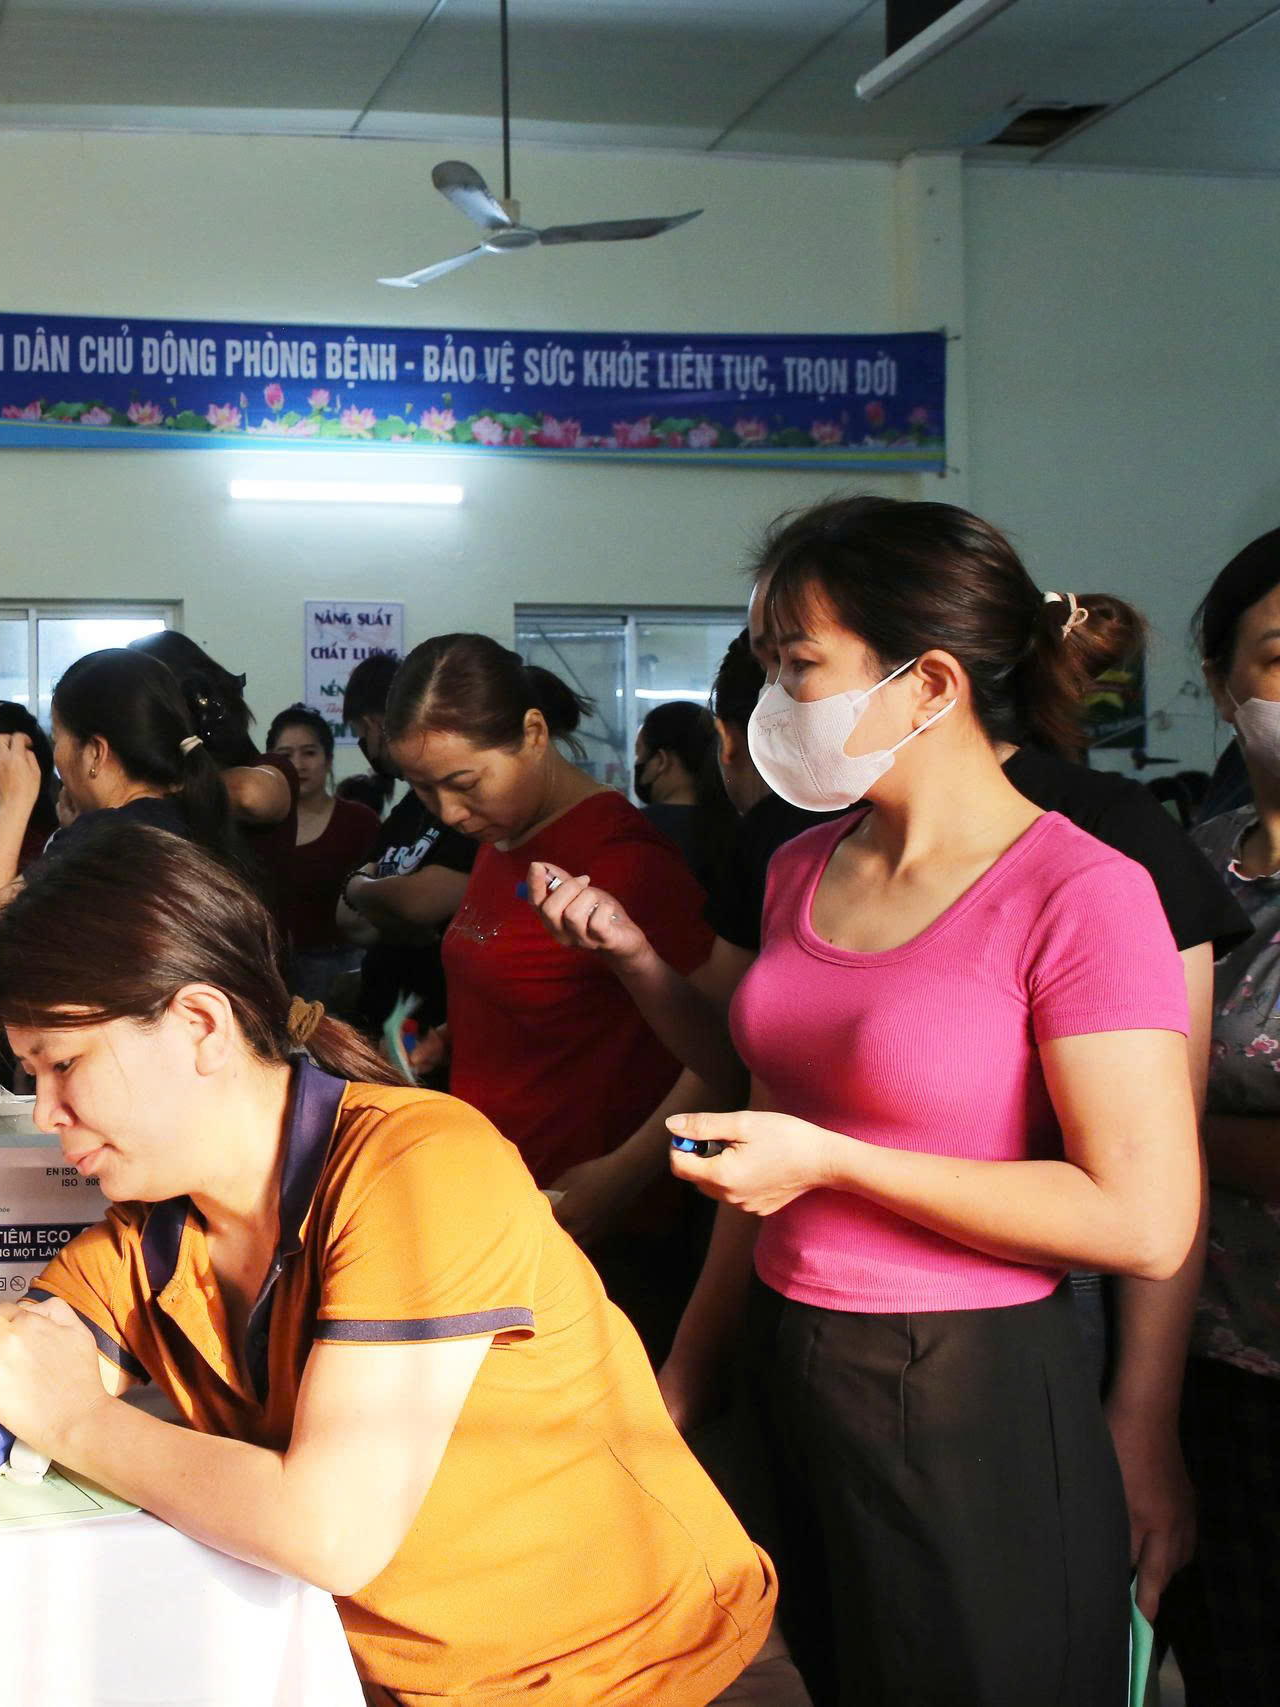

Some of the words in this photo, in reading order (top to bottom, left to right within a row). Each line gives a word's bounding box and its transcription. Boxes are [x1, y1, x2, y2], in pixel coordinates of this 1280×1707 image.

[14, 327, 70, 372] DÂN
[80, 324, 133, 375] CHỦ
[142, 331, 217, 383] ĐỘNG
[226, 331, 318, 380] PHÒNG
[326, 335, 396, 389] BỆNH
[423, 335, 477, 383] BẢO
[483, 341, 516, 393] VỆ
[524, 341, 575, 386] SỨC
[583, 340, 649, 389] KHỎE
[657, 346, 713, 390] LIÊN
[720, 354, 776, 400] TỤC,
[784, 356, 848, 402] TRỌN
[855, 350, 897, 397] ĐỜI
[314, 609, 352, 625] NĂNG
[46, 1167, 59, 1176] EN
[61, 1167, 79, 1176] ISO
[61, 1178, 78, 1187] ISO
[36, 1230, 71, 1243] ECO
